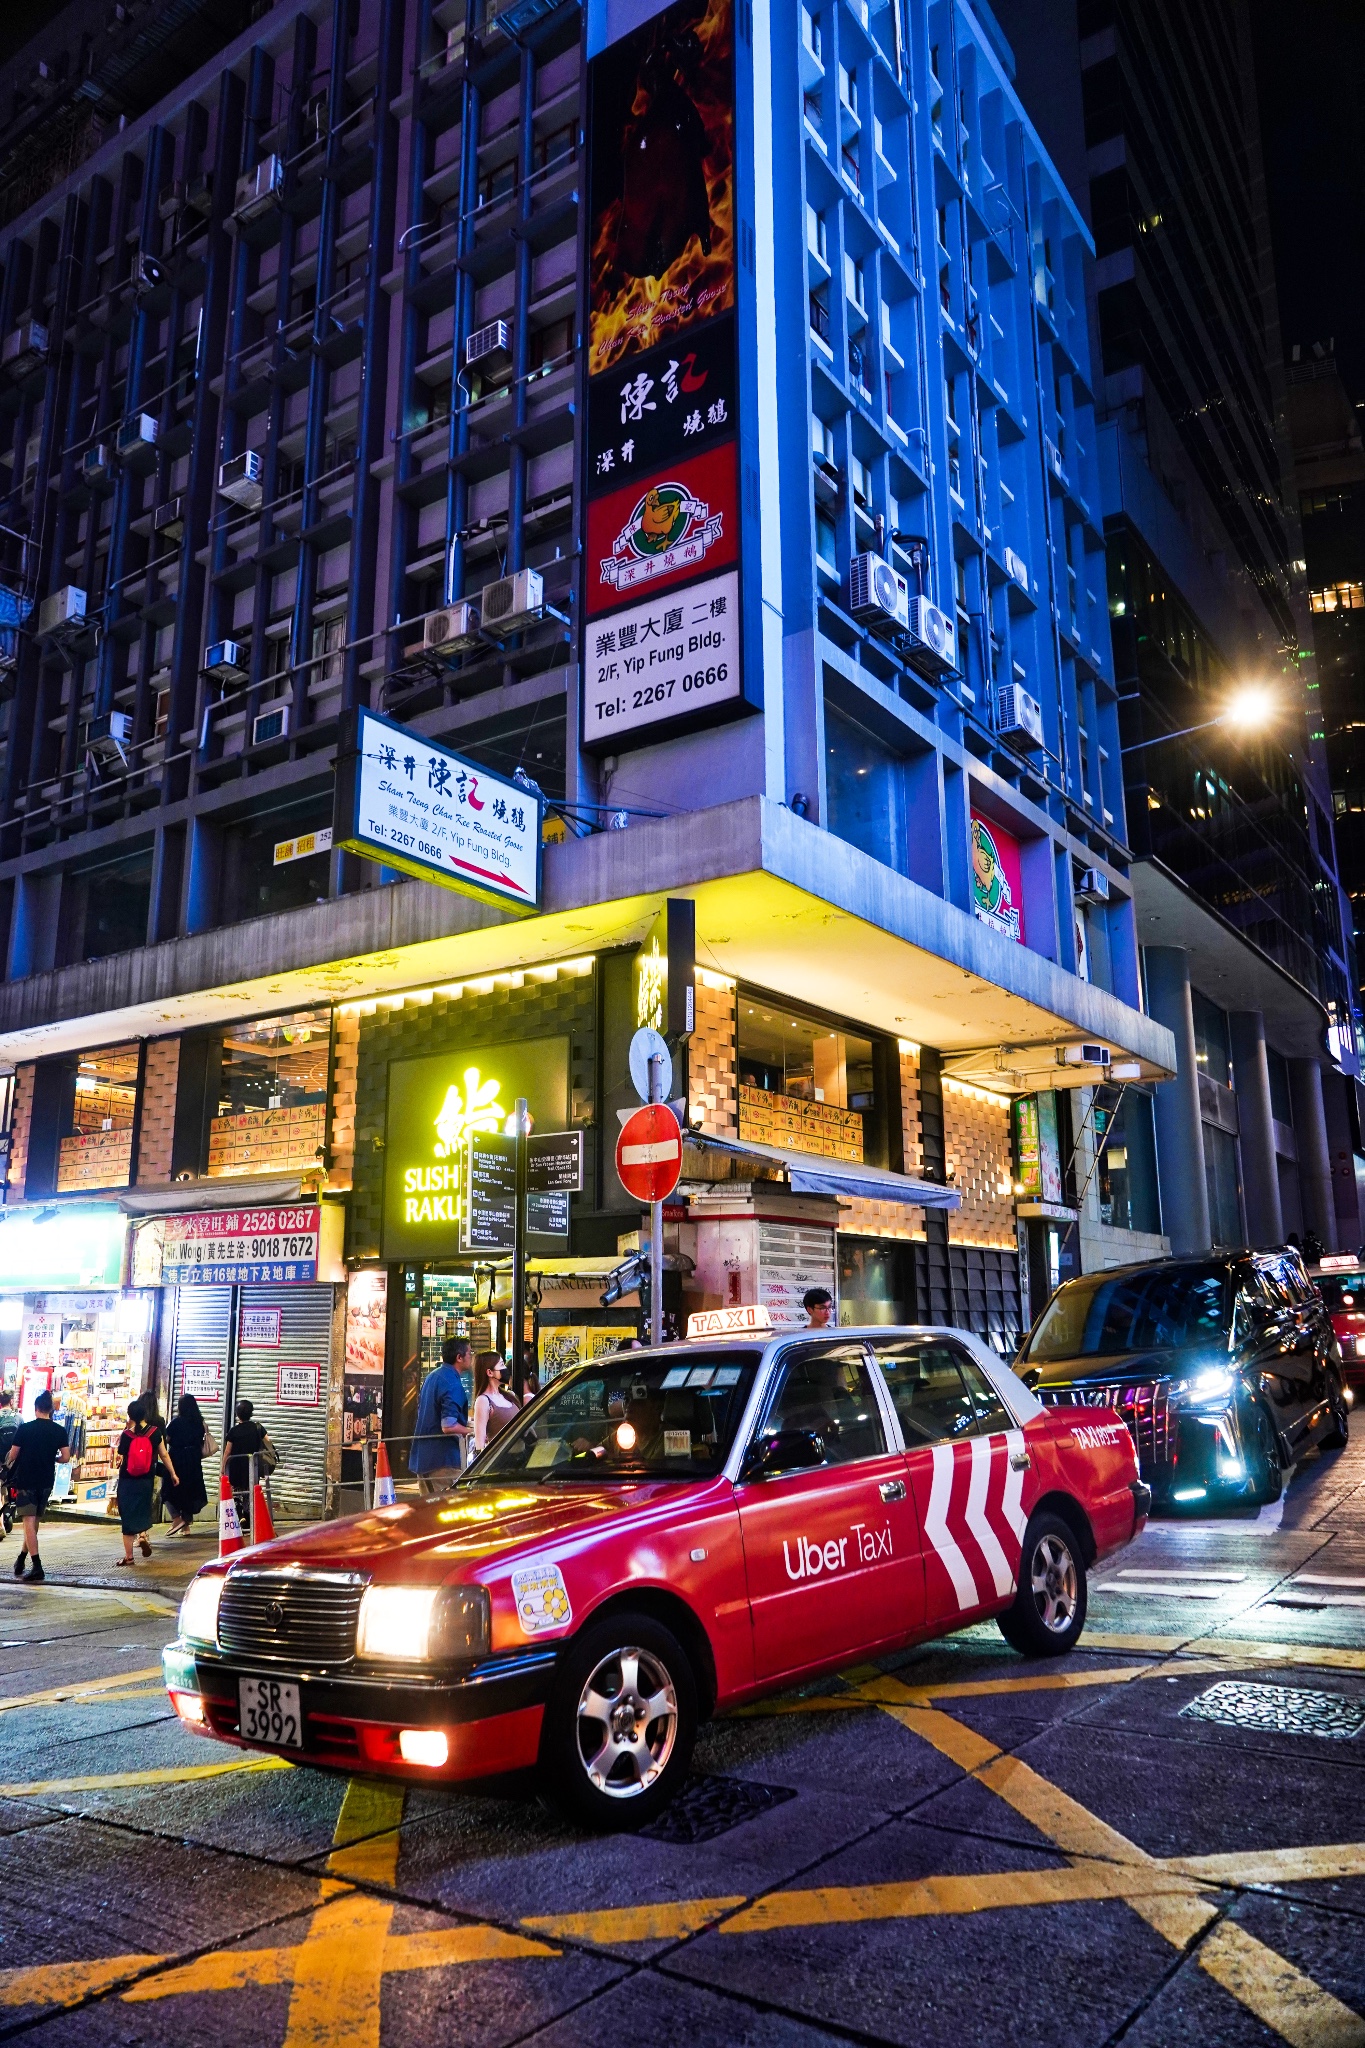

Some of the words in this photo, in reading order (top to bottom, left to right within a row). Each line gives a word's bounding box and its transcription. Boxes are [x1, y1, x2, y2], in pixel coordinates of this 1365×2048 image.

[620, 353, 708, 425] 陳記
[597, 440, 635, 476] 深井
[596, 607, 684, 648] 業豐大廈
[692, 596, 727, 625] 二樓
[598, 663, 620, 683] 2/F,
[624, 657, 645, 674] Yip
[650, 644, 684, 666] Fung
[688, 630, 725, 653] Bldg.
[595, 697, 626, 720] Tel:
[632, 679, 676, 709] 2267
[682, 663, 728, 693] 0666
[379, 743, 416, 781] 深井
[378, 780, 403, 798] Sham
[407, 790, 429, 812] Tseng
[433, 804, 453, 820] Chan
[456, 813, 471, 828] Kee
[473, 821, 502, 842] Roasted
[504, 835, 523, 851] Goose
[368, 819, 387, 838] Tel:
[390, 829, 415, 848] 2267
[418, 841, 442, 860] 0666
[431, 822, 448, 841] 2/F,
[450, 831, 465, 848] Yip
[467, 837, 489, 860] Fung
[491, 848, 512, 869] Bldg.
[404, 1164, 461, 1194] SUSH
[242, 1211, 276, 1232] 2526
[279, 1209, 314, 1230] 0267
[251, 1238, 279, 1258] 9018
[282, 1236, 314, 1257] 7672
[542, 1279, 597, 1291] INANCIAL
[692, 1308, 756, 1332] TAXI
[1071, 1425, 1100, 1450] TAXI
[782, 1535, 848, 1580] Uber
[850, 1519, 893, 1563] Taxi
[258, 1681, 282, 1713] SR
[246, 1708, 298, 1745] 3992
